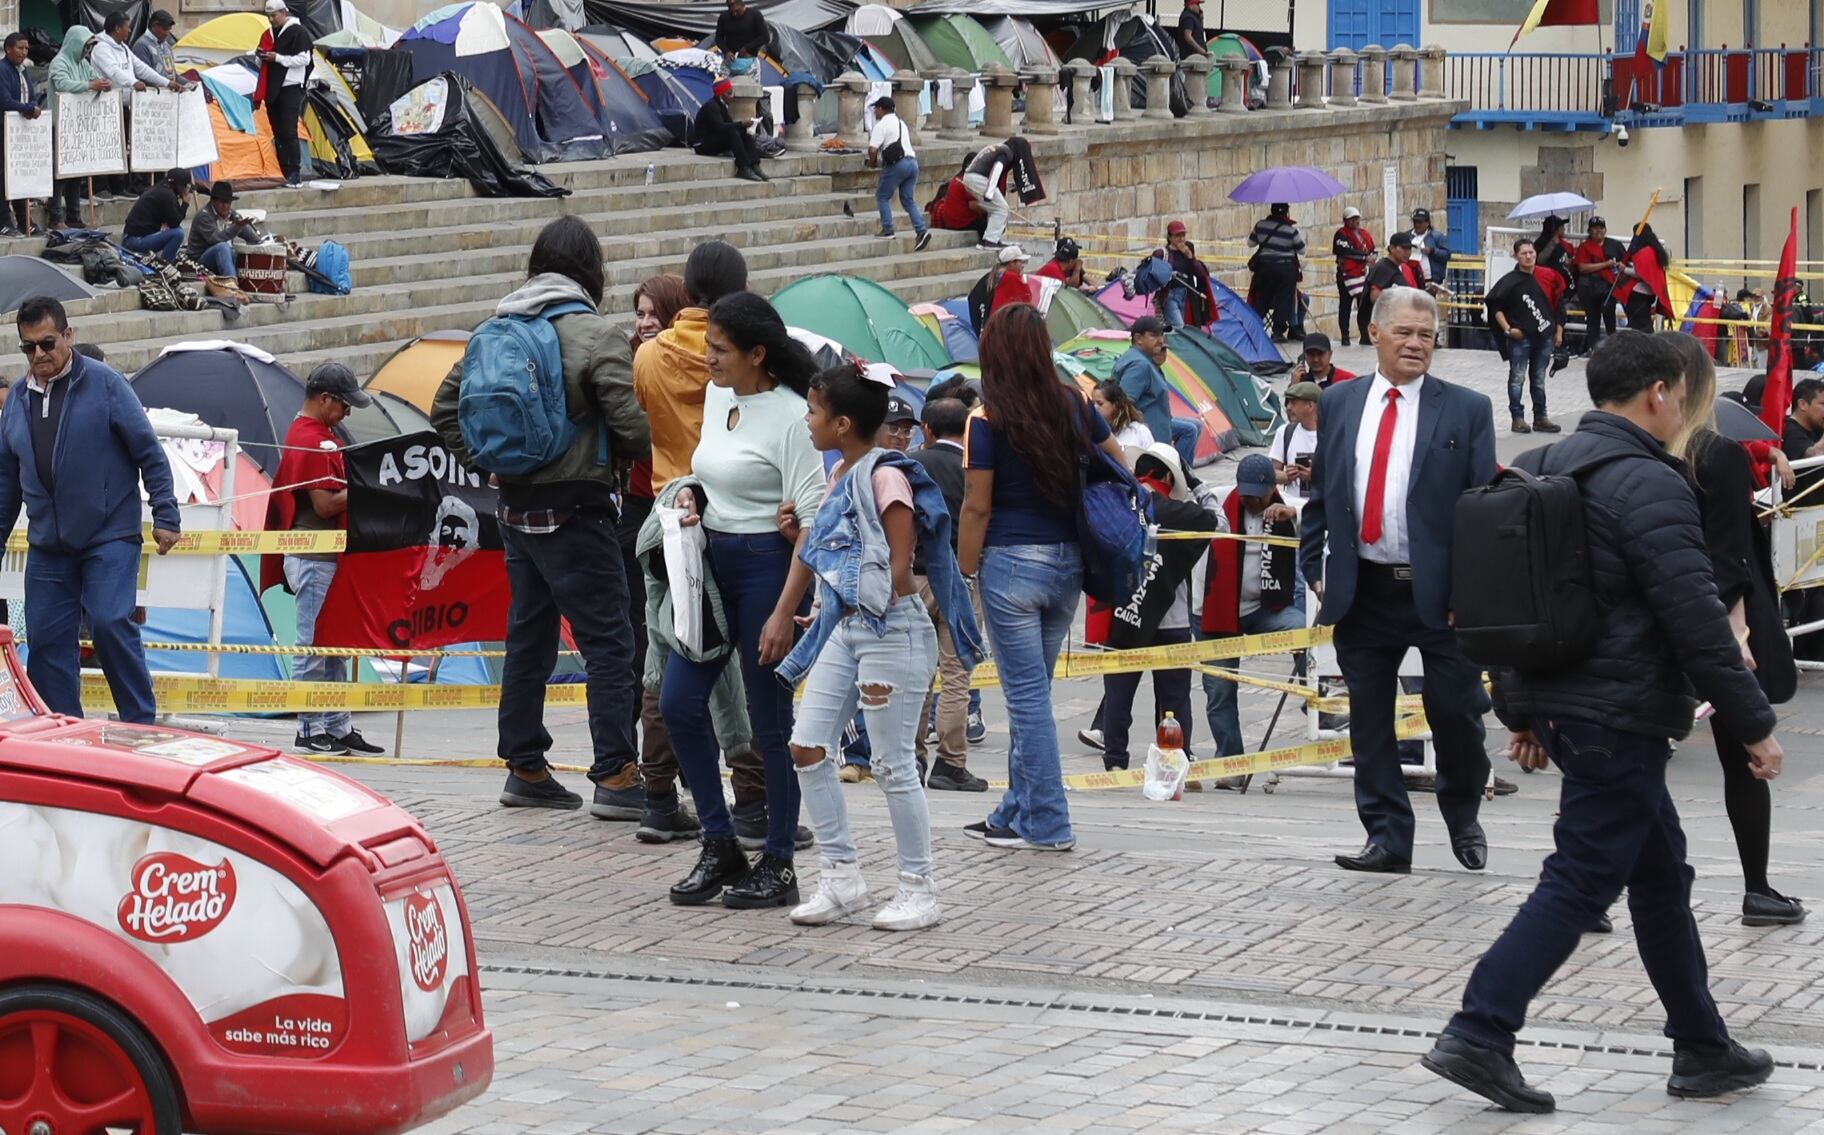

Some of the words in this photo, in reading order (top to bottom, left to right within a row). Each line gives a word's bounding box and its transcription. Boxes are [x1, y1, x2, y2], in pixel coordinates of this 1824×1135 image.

[1114, 606, 1143, 629] CAUCA
[140, 862, 219, 899] Crem
[126, 891, 226, 937] Helado
[408, 901, 439, 944] Crem
[412, 924, 446, 985] Helado
[225, 1028, 263, 1043] sabe
[266, 1029, 297, 1045] más
[301, 1033, 330, 1049] rico
[275, 1015, 294, 1030] La
[297, 1018, 332, 1033] vida
